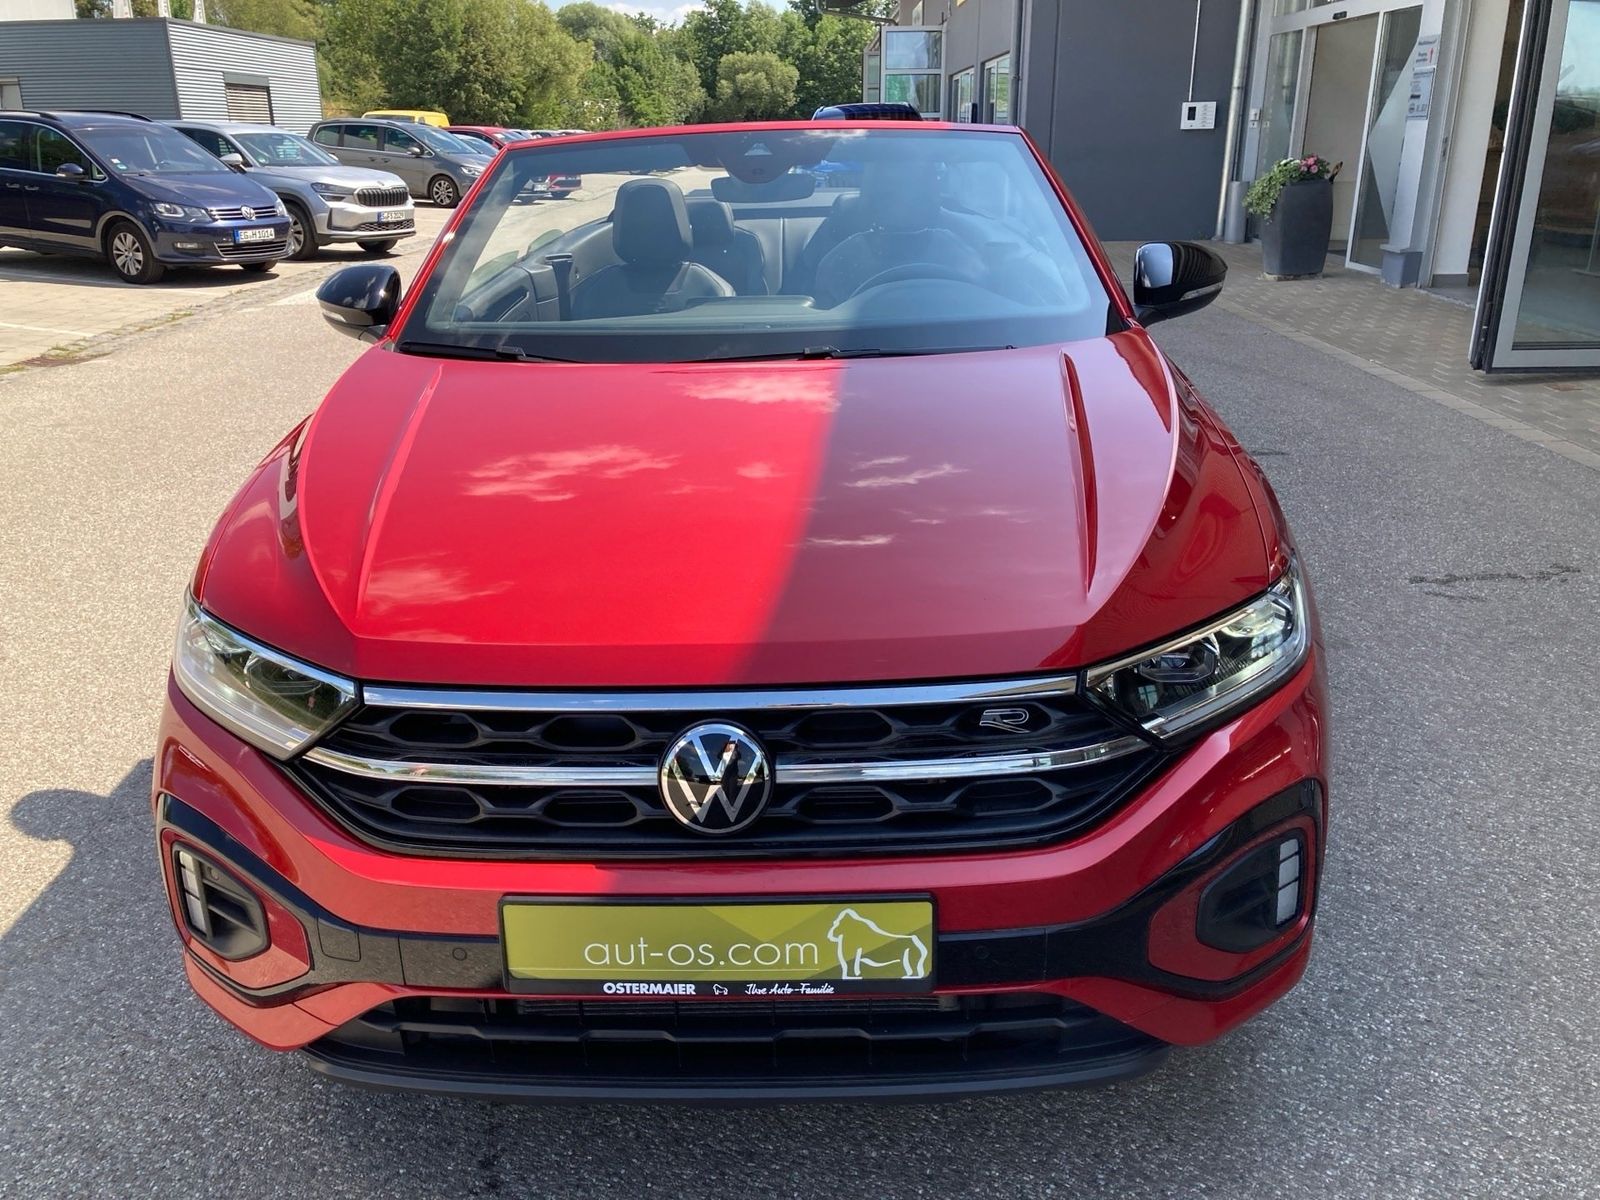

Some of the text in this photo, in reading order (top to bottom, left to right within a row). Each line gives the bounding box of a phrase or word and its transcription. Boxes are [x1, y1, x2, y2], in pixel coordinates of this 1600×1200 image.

[661, 723, 771, 834] VW
[584, 937, 818, 965] aut-os.com
[603, 982, 696, 995] OSTERMAIER
[745, 983, 768, 995] Ihre
